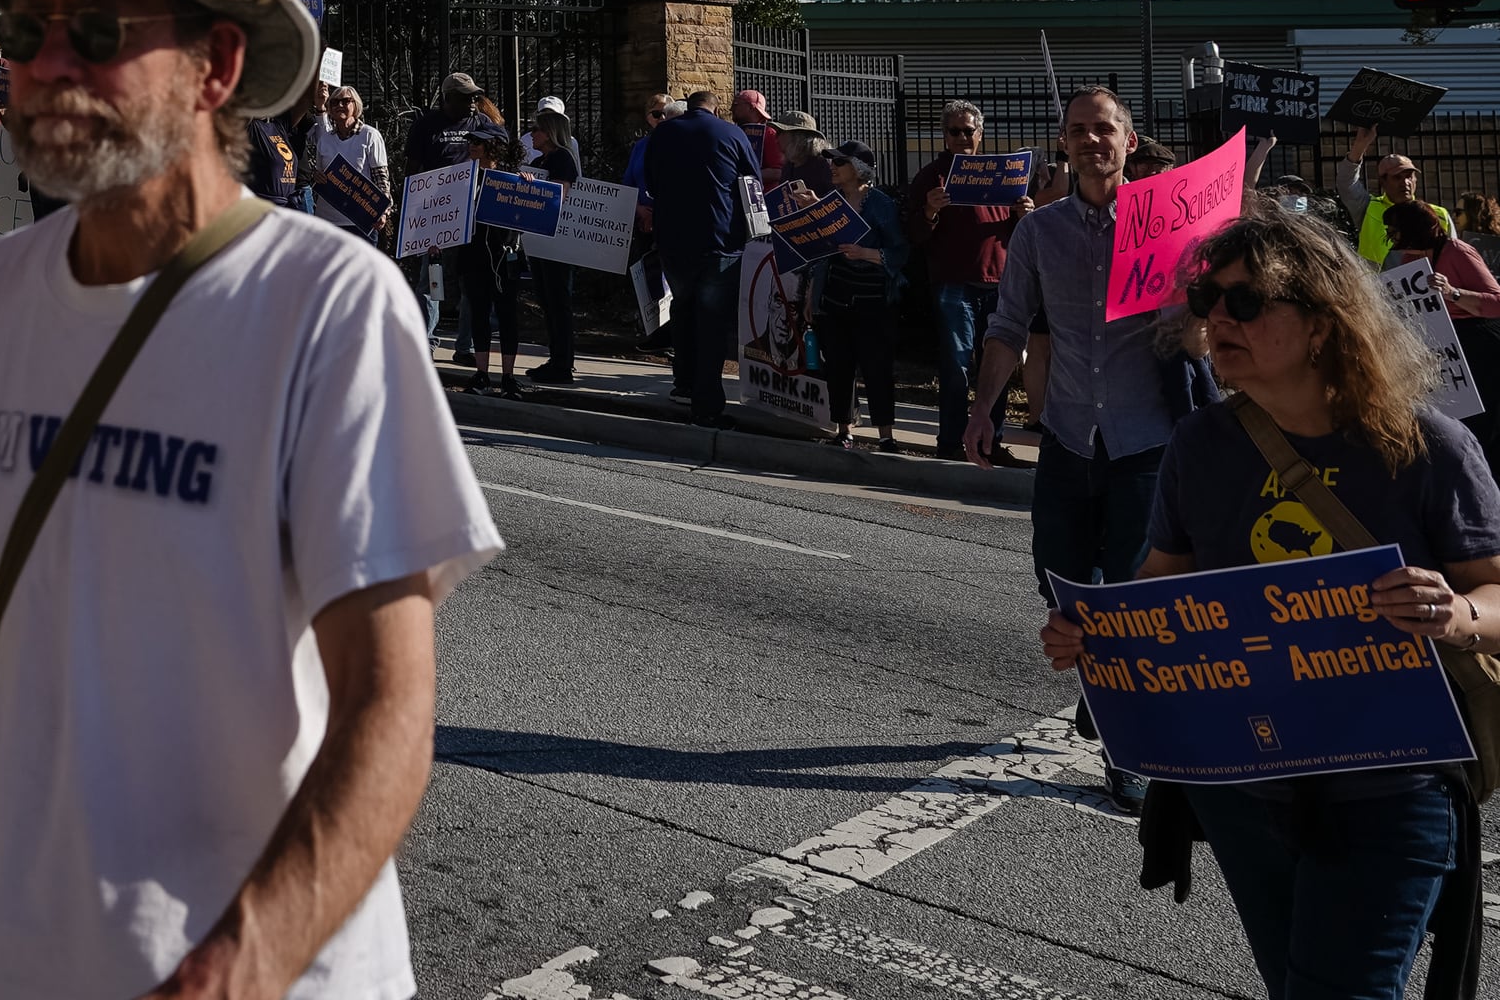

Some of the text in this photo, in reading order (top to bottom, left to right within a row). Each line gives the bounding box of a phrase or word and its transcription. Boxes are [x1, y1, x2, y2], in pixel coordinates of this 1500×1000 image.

[1225, 72, 1314, 97] PINK SLIPS
[1351, 73, 1434, 104] SUPPORT
[1230, 94, 1317, 120] SINK SHIPS
[1351, 99, 1401, 122] CDC
[339, 164, 353, 181] Stop
[352, 175, 363, 188] the
[961, 159, 997, 172] Saving the
[1005, 158, 1025, 171] Saving
[327, 170, 353, 195] America's
[409, 168, 471, 193] CDC Saves
[485, 176, 554, 199] Congress: Hold the Line
[571, 181, 620, 198] ERNMENT
[950, 174, 993, 185] Civil Service
[1001, 174, 1028, 186] America!
[423, 194, 452, 210] Lives
[496, 192, 546, 211] Don't Surrender!
[564, 196, 608, 213] FICIENT:
[409, 207, 460, 230] We must
[774, 198, 844, 234] Government Workers
[404, 228, 460, 251] save CDC
[573, 228, 629, 249] VANDALS!
[790, 213, 851, 245] Work for America!
[1386, 270, 1429, 301] LIC
[749, 366, 824, 405] NO RFK JR.
[29, 413, 218, 506] VTING
[1260, 467, 1340, 498] AE
[1264, 579, 1377, 624] Saving
[1075, 595, 1229, 644] Saving the
[1242, 636, 1272, 652] =
[1289, 634, 1432, 681] America!
[1080, 653, 1251, 693] Civil Service
[1140, 762, 1185, 774] AMERICAN
[1186, 764, 1242, 775] FEDERATION
[1244, 764, 1256, 772] OF
[1258, 756, 1326, 770] GOVERNMENT
[1390, 747, 1428, 758] AFL-CIO
